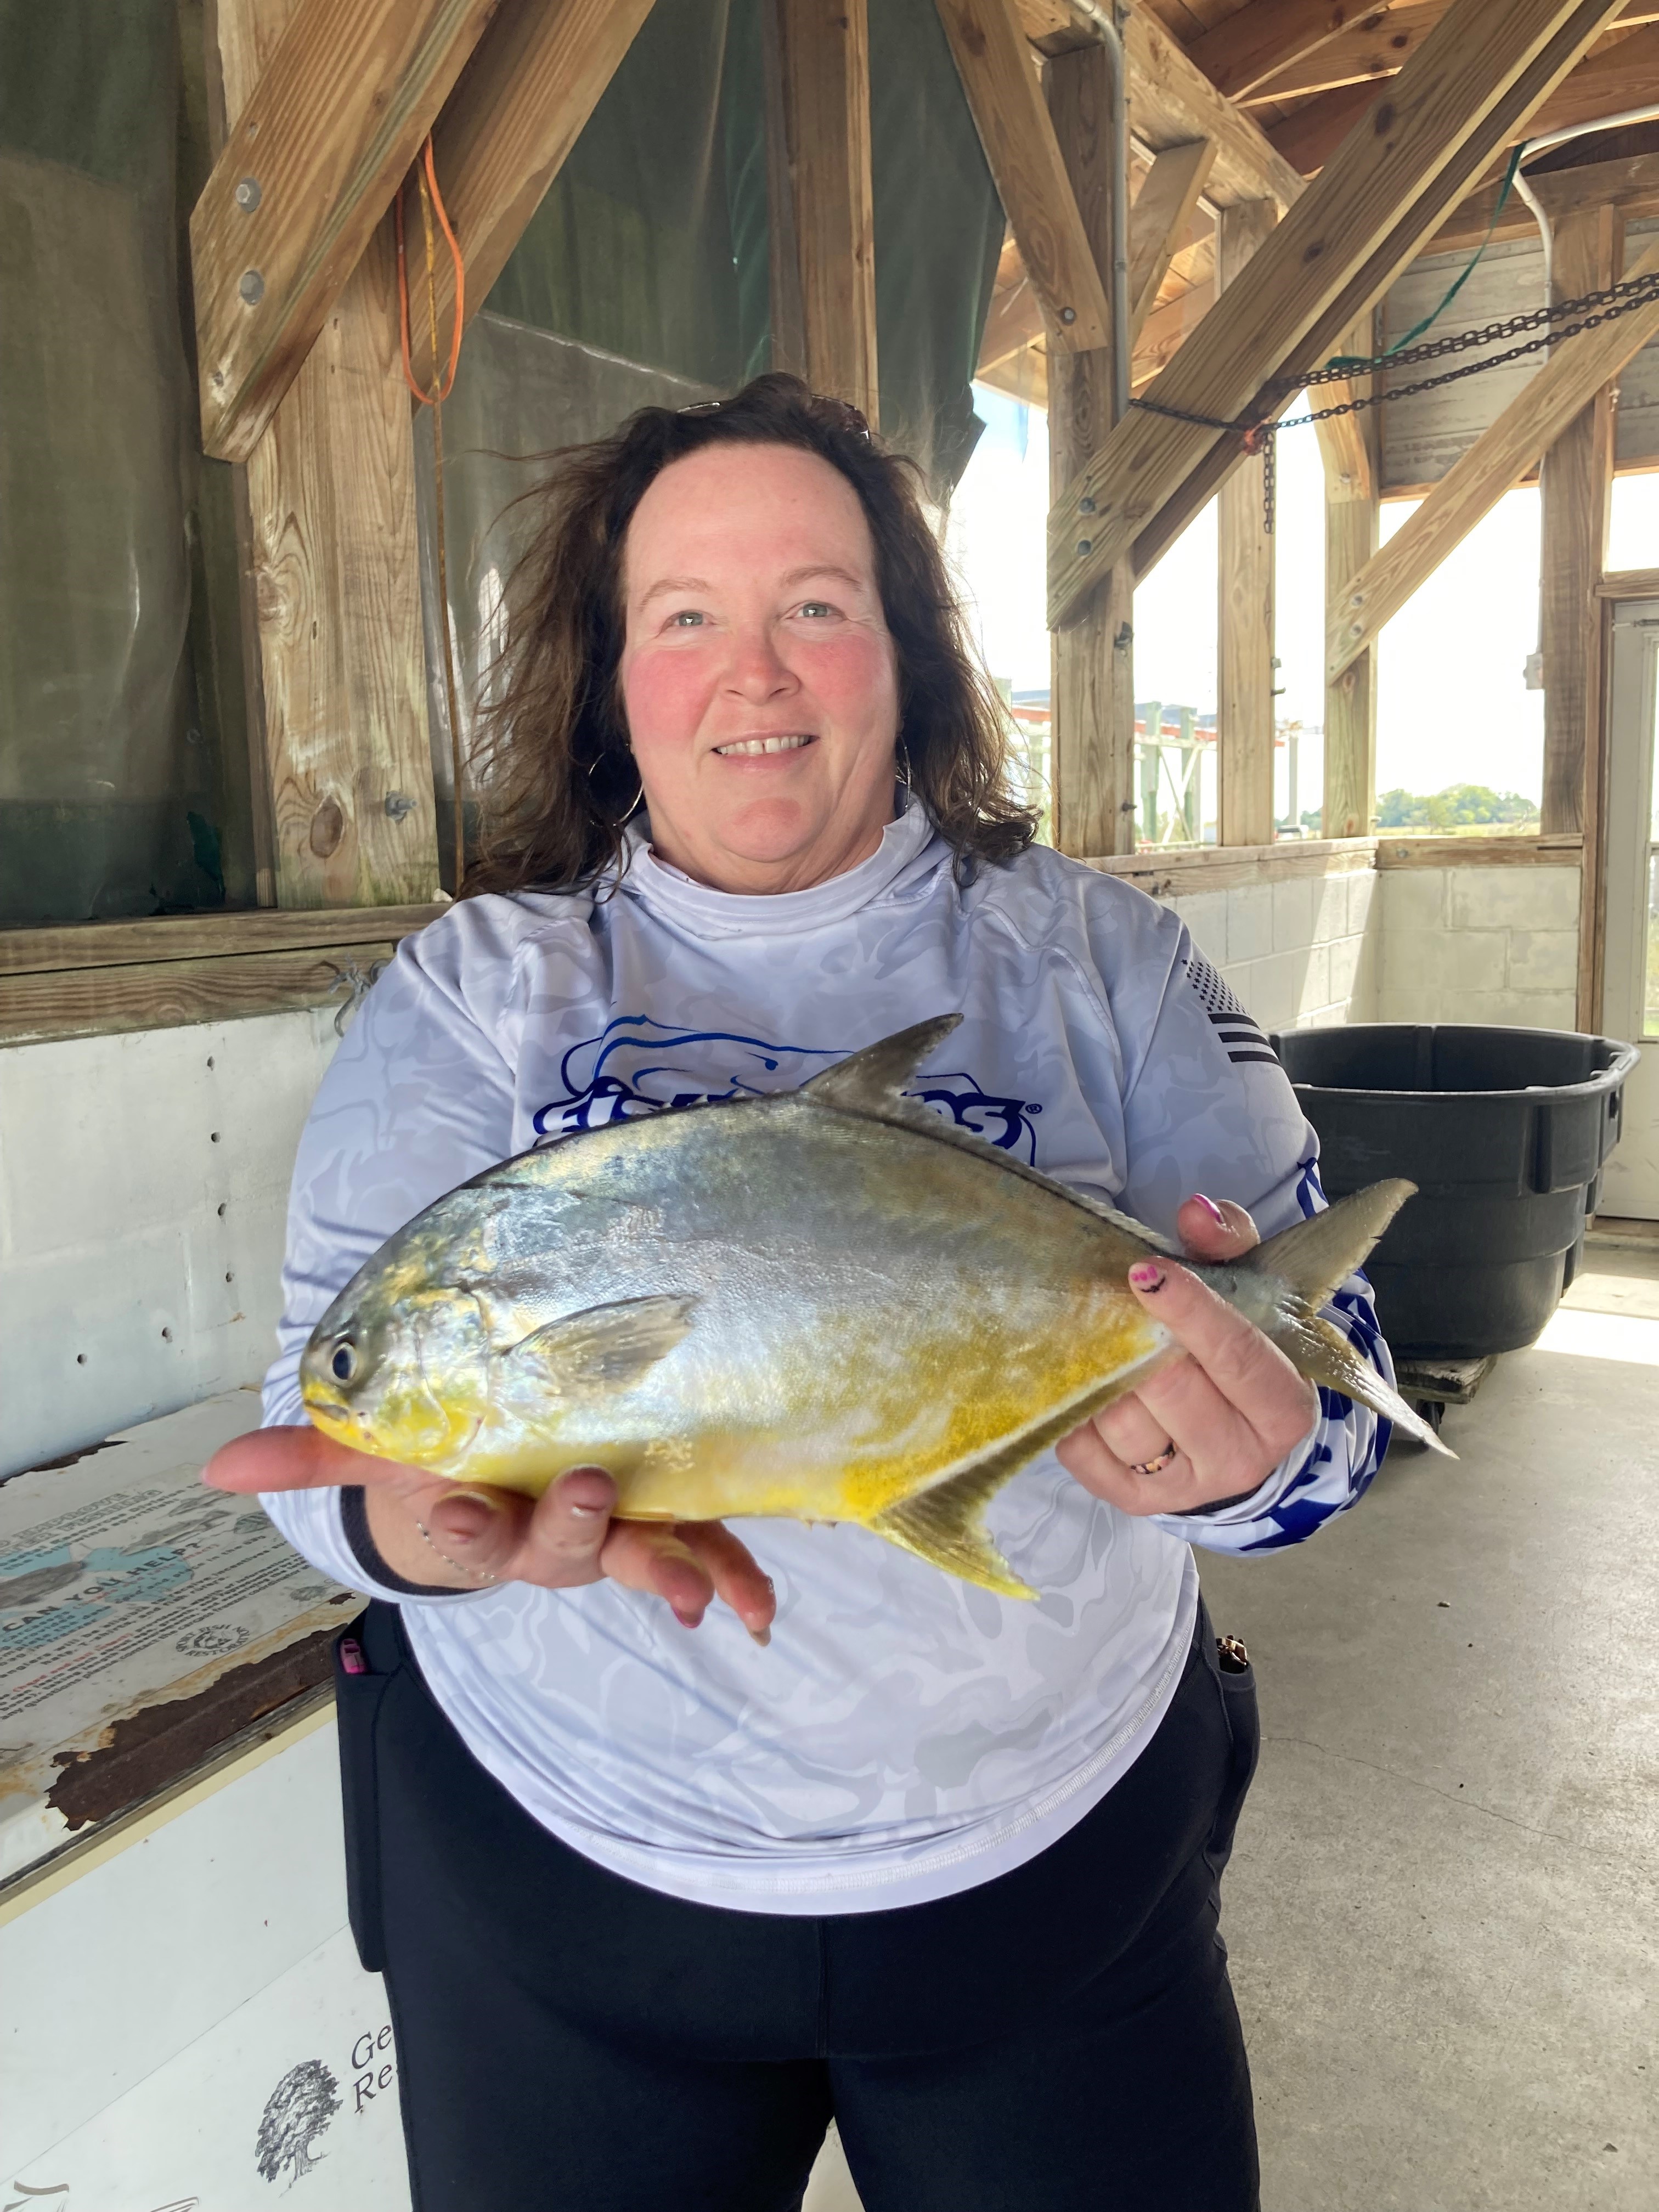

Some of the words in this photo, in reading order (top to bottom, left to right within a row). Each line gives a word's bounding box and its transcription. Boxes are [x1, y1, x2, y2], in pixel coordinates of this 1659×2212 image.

[128, 1490, 185, 1512] Division
[2, 1606, 61, 1633] CAN
[64, 1578, 123, 1601] YOU
[126, 1542, 201, 1576] HELP?
[53, 1621, 79, 1632] the
[82, 1606, 111, 1620] data
[146, 1578, 170, 1589] and
[138, 1607, 162, 1618] and
[14, 1615, 76, 1644] provided
[1, 1708, 24, 1720] any
[24, 1679, 82, 1707] questions
[82, 1660, 120, 1679] please
[120, 1639, 160, 1660] contact
[158, 1630, 178, 1639] the
[178, 1612, 215, 1630] carcass
[212, 1595, 247, 1612] freezer
[248, 1570, 300, 1595] coordinator
[54, 1639, 80, 1651] will
